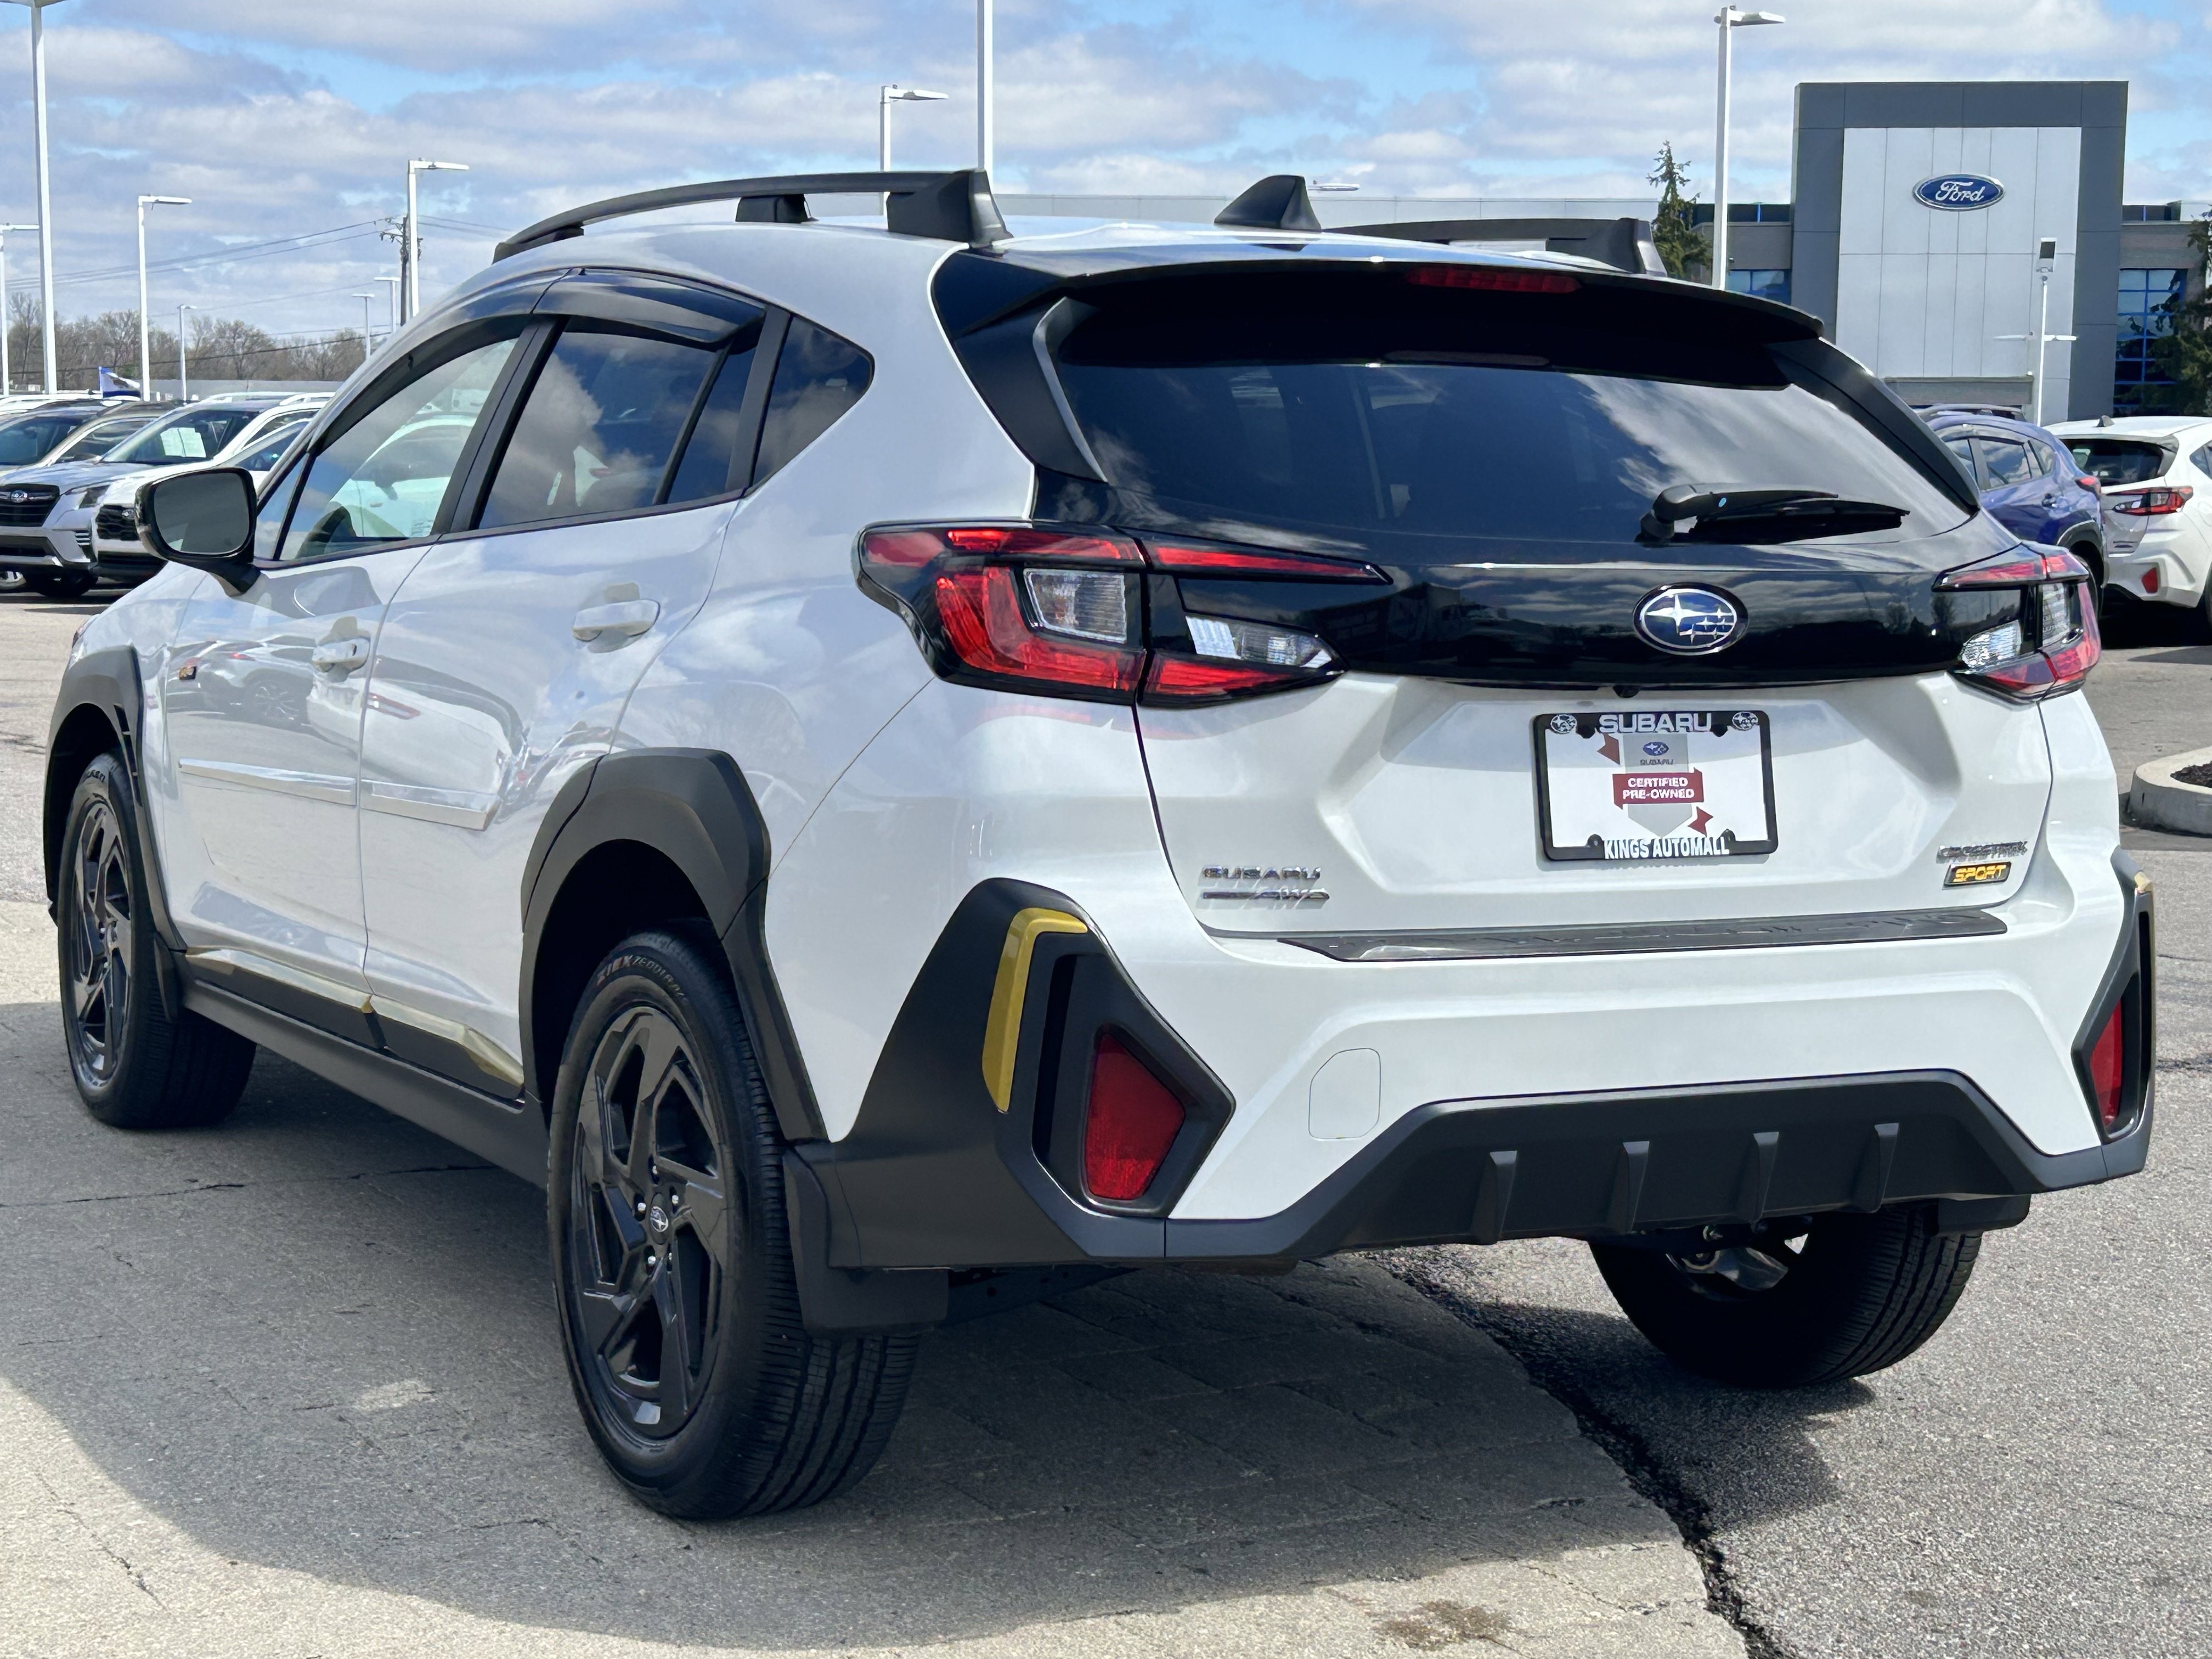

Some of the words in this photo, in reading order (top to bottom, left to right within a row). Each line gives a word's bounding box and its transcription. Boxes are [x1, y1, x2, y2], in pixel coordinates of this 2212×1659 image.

[1935, 181, 1985, 201] Ford
[1599, 713, 1712, 733] SUBARU
[1627, 777, 1689, 788] CERTIFIED
[1622, 788, 1695, 800] PRE-OWNED
[1604, 838, 1650, 860] KINGS
[1652, 837, 1730, 857] AUTOMALL
[1201, 865, 1321, 879] SUBARU
[1953, 864, 2006, 883] SPORT
